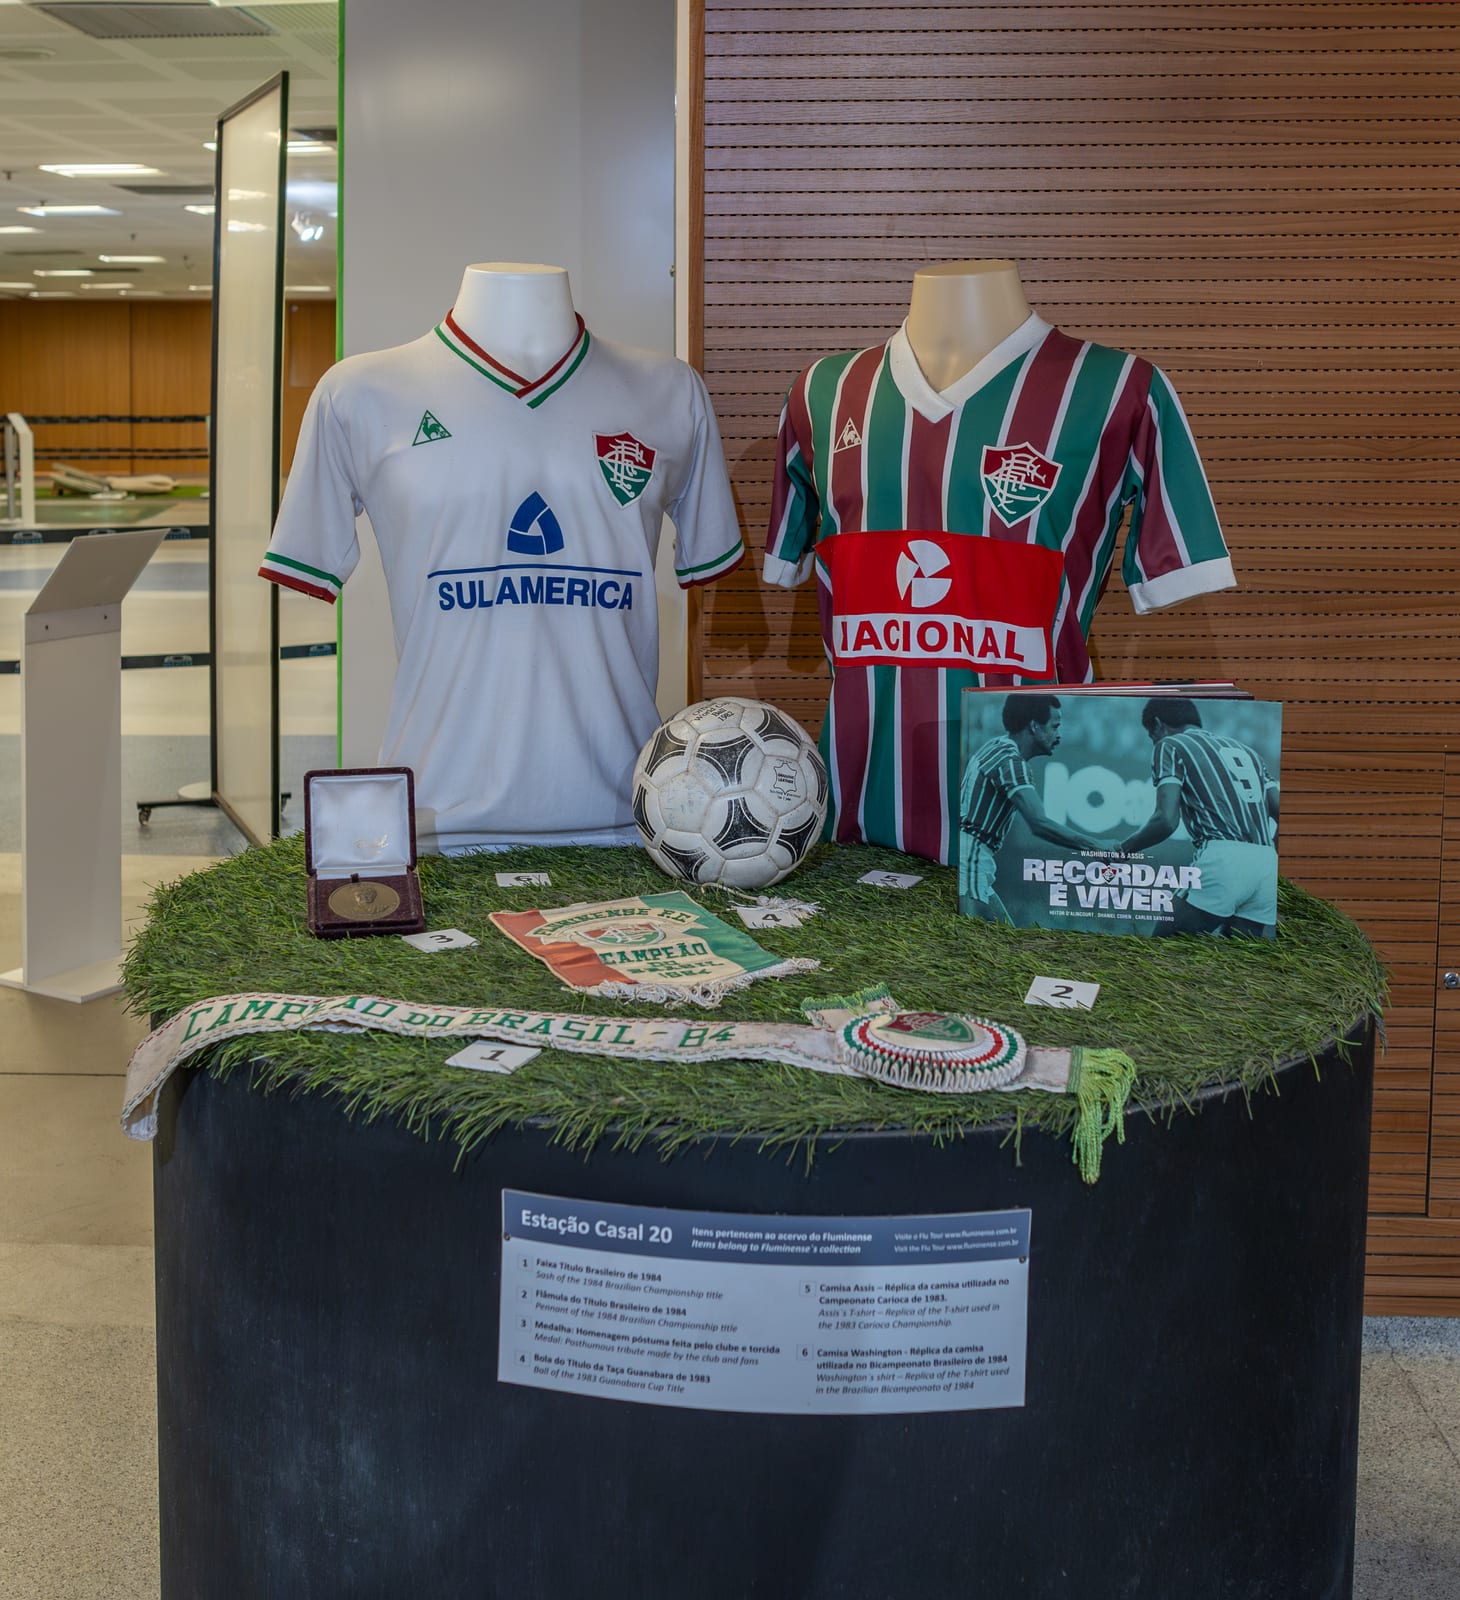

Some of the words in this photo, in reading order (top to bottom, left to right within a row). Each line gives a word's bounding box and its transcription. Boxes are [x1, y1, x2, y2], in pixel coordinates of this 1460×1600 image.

[1080, 850, 1119, 859] WASHINGTON
[1127, 852, 1145, 860] ASSIS
[1023, 858, 1202, 890] RECORDAR
[1050, 882, 1068, 907] É
[1075, 885, 1174, 912] VIVER
[761, 913, 781, 922] 4
[429, 934, 454, 943] 3
[599, 942, 708, 965] CAMPEÃO
[1051, 985, 1074, 999] 2
[400, 1010, 456, 1027] DO
[460, 1012, 635, 1045] BRASIL
[480, 1050, 506, 1062] 1
[521, 1209, 590, 1235] Estação
[595, 1220, 643, 1240] Casal
[649, 1225, 673, 1244] 20
[692, 1227, 714, 1237] Itens
[715, 1228, 763, 1241] pertencem
[764, 1232, 776, 1240] ao
[777, 1232, 808, 1241] acervo
[809, 1232, 821, 1241] do
[822, 1232, 873, 1242] Fluminense
[691, 1239, 716, 1249] Items
[717, 1240, 748, 1253] belong
[749, 1243, 759, 1251] to
[819, 1244, 861, 1254] collection
[522, 1259, 528, 1267] 1
[536, 1258, 557, 1269] Faixa
[585, 1265, 625, 1279] Brasileiro
[627, 1271, 638, 1279] de
[641, 1272, 662, 1282] 1984
[536, 1270, 555, 1280] Sash
[556, 1273, 567, 1283] of
[567, 1275, 580, 1284] the
[583, 1277, 604, 1287] 1984
[605, 1279, 642, 1292] Brazilian
[643, 1284, 704, 1299] Championship
[706, 1290, 723, 1299] title
[804, 1284, 811, 1293] 5
[820, 1284, 851, 1292] Camisa
[854, 1283, 875, 1292] Assis
[885, 1282, 916, 1293] Réplica
[917, 1281, 928, 1290] da
[930, 1281, 960, 1290] camisa
[961, 1278, 997, 1288] utilizada
[998, 1278, 1010, 1286] no
[521, 1289, 528, 1298] 2
[819, 1296, 876, 1306] Campeonato
[877, 1295, 909, 1304] Carioca
[911, 1294, 922, 1303] de
[570, 1294, 581, 1304] do
[609, 1300, 650, 1313] Brasileiro
[652, 1305, 663, 1314] de
[666, 1306, 687, 1316] 1984
[849, 1308, 876, 1317] T-shirt
[885, 1307, 916, 1318] Replica
[917, 1306, 926, 1317] of
[928, 1306, 942, 1314] the
[971, 1303, 991, 1313] used
[991, 1303, 1000, 1311] in
[521, 1319, 527, 1328] 3
[535, 1301, 568, 1314] Pennant
[570, 1307, 579, 1318] of
[581, 1309, 595, 1318] the
[597, 1311, 617, 1321] 1984
[619, 1313, 656, 1327] Brazilian
[658, 1318, 719, 1333] Championship
[720, 1323, 738, 1333] title
[818, 1320, 833, 1329] the
[834, 1320, 857, 1330] 1983
[858, 1320, 890, 1329] Carioca
[576, 1327, 630, 1342] Homenagem
[632, 1334, 670, 1346] póstuma
[671, 1338, 692, 1348] feita
[694, 1340, 714, 1351] pelo
[715, 1341, 740, 1352] clube
[749, 1344, 780, 1354] torcida
[520, 1354, 526, 1363] 4
[565, 1336, 614, 1352] Posthumous
[616, 1344, 645, 1356] tribute
[647, 1349, 671, 1359] made
[673, 1351, 684, 1361] by
[685, 1352, 700, 1361] the
[701, 1353, 720, 1363] club
[721, 1355, 739, 1364] and
[740, 1356, 759, 1366] fans
[802, 1348, 808, 1357] 6
[817, 1348, 849, 1357] Camisa
[850, 1347, 902, 1359] Washington
[910, 1346, 940, 1357] Réplica
[942, 1345, 953, 1354] da
[955, 1344, 984, 1353] camisa
[534, 1353, 552, 1364] Bola
[554, 1356, 565, 1366] do
[593, 1362, 604, 1371] da
[606, 1364, 624, 1375] Taça
[626, 1367, 674, 1381] Guanabara
[675, 1372, 687, 1381] de
[690, 1373, 711, 1383] 1983
[816, 1361, 854, 1370] utilizada
[870, 1359, 931, 1370] Bicampeonato
[933, 1357, 973, 1367] Brasileiro
[974, 1356, 986, 1365] de
[988, 1354, 1008, 1364] 1984
[533, 1365, 549, 1375] Ball
[550, 1368, 560, 1379] of
[561, 1370, 574, 1379] the
[577, 1372, 597, 1383] 1983
[599, 1375, 646, 1389] Guanabara
[647, 1382, 664, 1392] Cup
[666, 1383, 685, 1393] Title
[877, 1372, 895, 1381] shirt
[905, 1371, 935, 1382] Replica
[936, 1370, 946, 1381] of
[947, 1370, 960, 1378] the
[990, 1366, 1010, 1376] used
[826, 1385, 840, 1394] the
[842, 1385, 879, 1394] Brazilian
[881, 1384, 941, 1395] Bicampeonato
[943, 1382, 952, 1392] of
[954, 1380, 975, 1390] 1984
